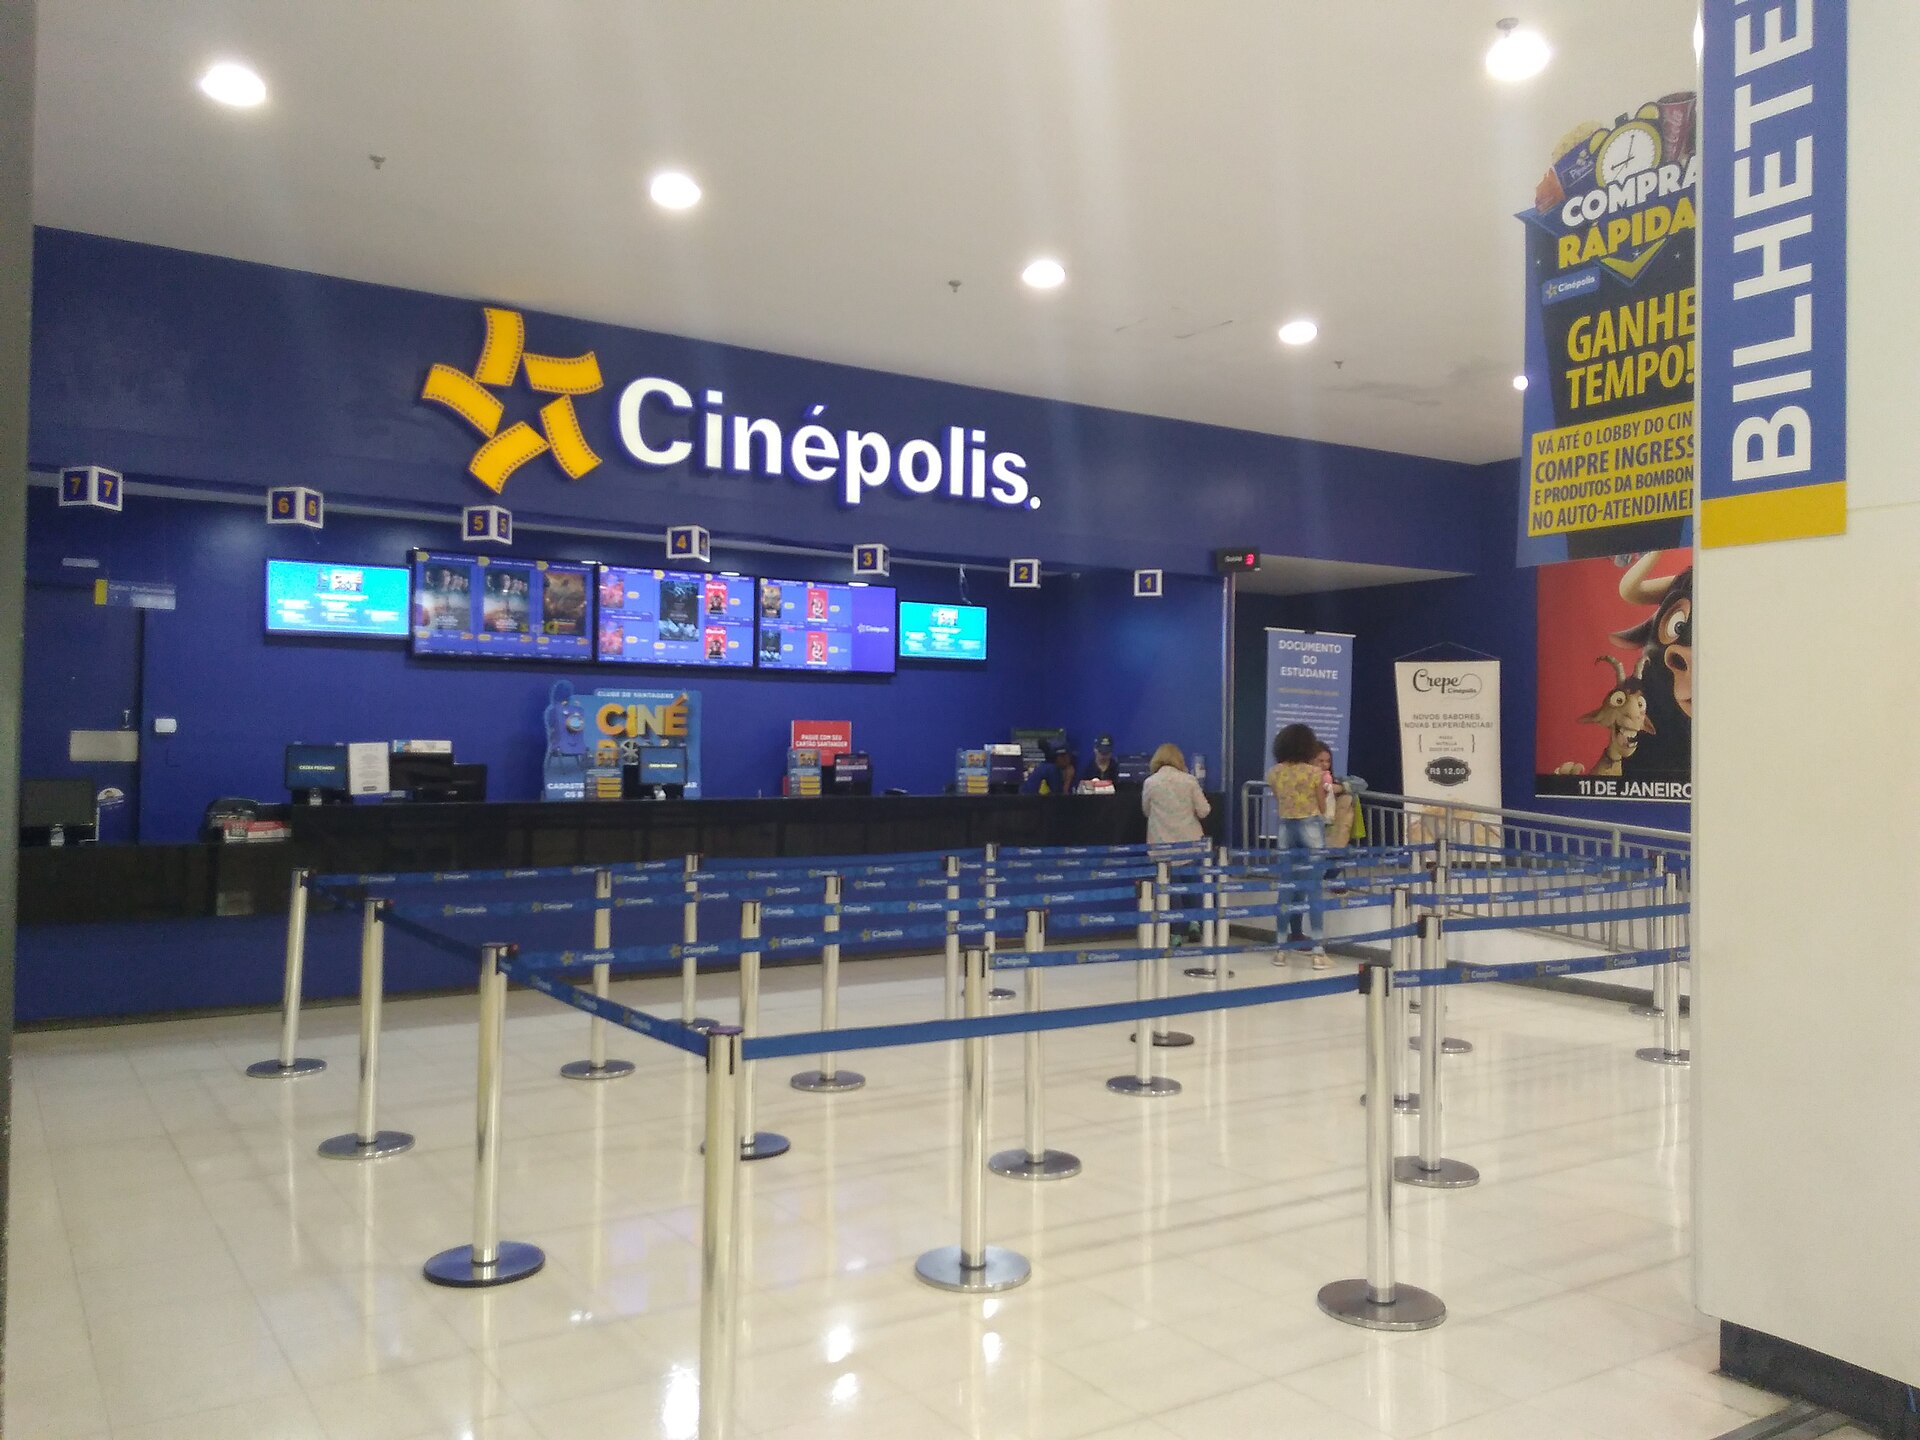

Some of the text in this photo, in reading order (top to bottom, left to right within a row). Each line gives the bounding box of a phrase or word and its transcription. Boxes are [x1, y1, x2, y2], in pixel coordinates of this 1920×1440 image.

[1562, 155, 1697, 226] COMPRA
[1558, 196, 1696, 269] RÁPIDA
[1732, 0, 1813, 481] BILHETE
[1567, 287, 1695, 362] GANHE
[1566, 341, 1694, 409] TEMPO!
[1538, 435, 1554, 455] VÁ
[1557, 431, 1580, 452] ATÉ
[1583, 431, 1593, 447] O
[1596, 421, 1641, 445] LOBBY
[1644, 417, 1664, 436] DO
[1535, 450, 1609, 484] COMPRE
[70, 477, 82, 496] 7
[103, 479, 113, 498] 7
[1534, 489, 1541, 505] E
[1544, 478, 1611, 504] PRODUTOS
[1614, 474, 1632, 493] DA
[277, 496, 290, 514] 6
[307, 500, 317, 517] 6
[473, 515, 485, 531] 5
[1532, 511, 1553, 531] NO
[863, 551, 873, 566] 3
[1018, 566, 1029, 580] 2
[1144, 577, 1152, 589] 1
[1279, 640, 1342, 654] DOCUMENTO
[1303, 655, 1317, 665] DO
[1281, 666, 1338, 680] ESTUDANTE
[1413, 669, 1462, 694] Crepe
[596, 692, 689, 738] CINÉ
[1430, 767, 1466, 776] R$ 12,00
[1579, 781, 1591, 795] 11
[1595, 781, 1617, 795] DE
